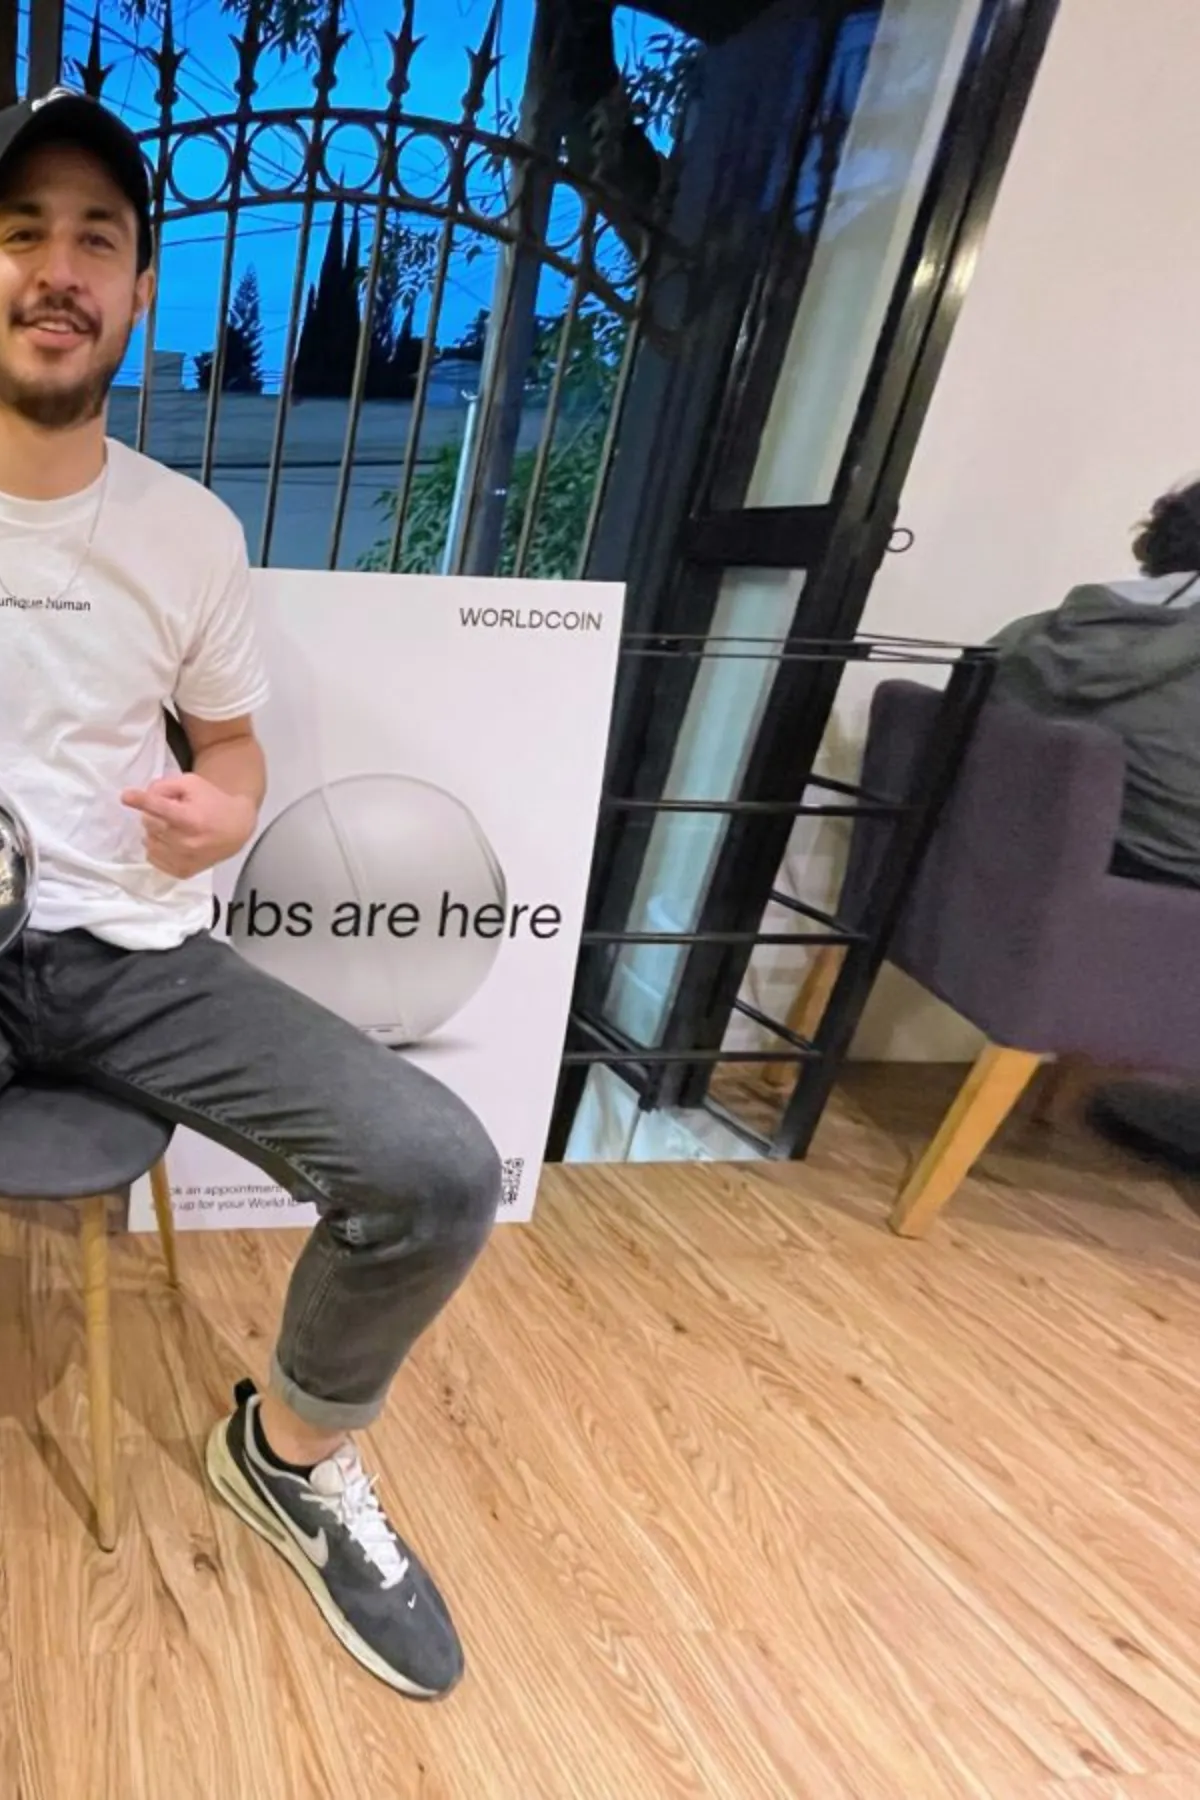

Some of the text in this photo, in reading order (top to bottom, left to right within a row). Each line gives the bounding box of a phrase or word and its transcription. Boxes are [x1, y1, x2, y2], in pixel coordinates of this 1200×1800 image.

[45, 596, 91, 612] human
[459, 607, 602, 631] WORLDCOIN
[211, 888, 562, 939] rbs are here
